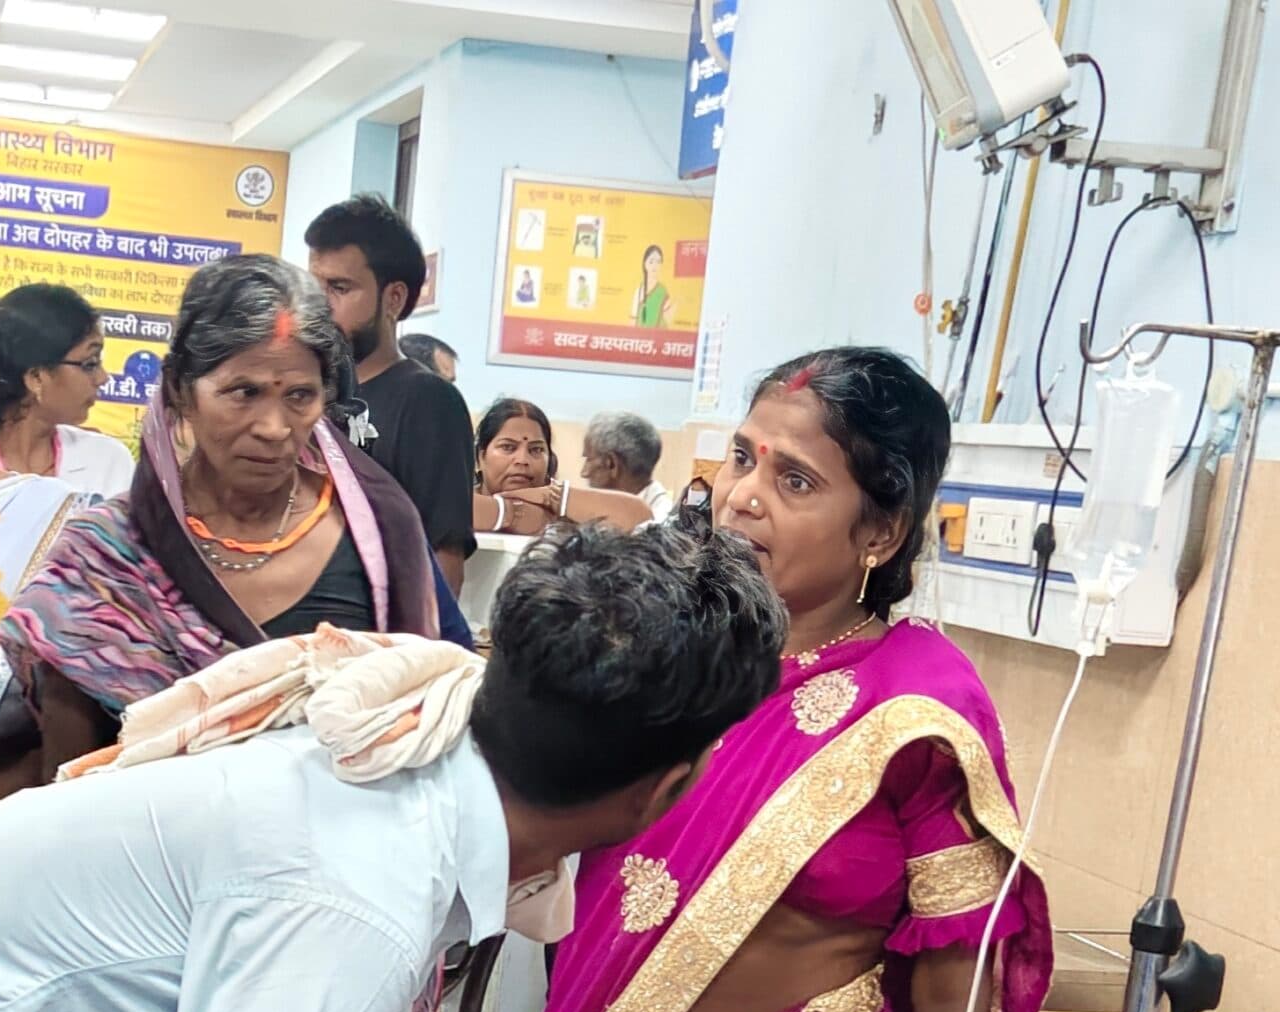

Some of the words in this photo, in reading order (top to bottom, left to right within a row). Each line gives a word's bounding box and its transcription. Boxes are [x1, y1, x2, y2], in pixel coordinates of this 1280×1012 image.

[53, 130, 115, 162] विभाग
[42, 158, 84, 176] सरकार
[34, 186, 86, 213] सूचना
[13, 223, 40, 245] अब
[43, 223, 93, 251] दोपहर
[95, 228, 114, 252] के
[117, 235, 146, 257] बाद
[149, 235, 169, 259] भी
